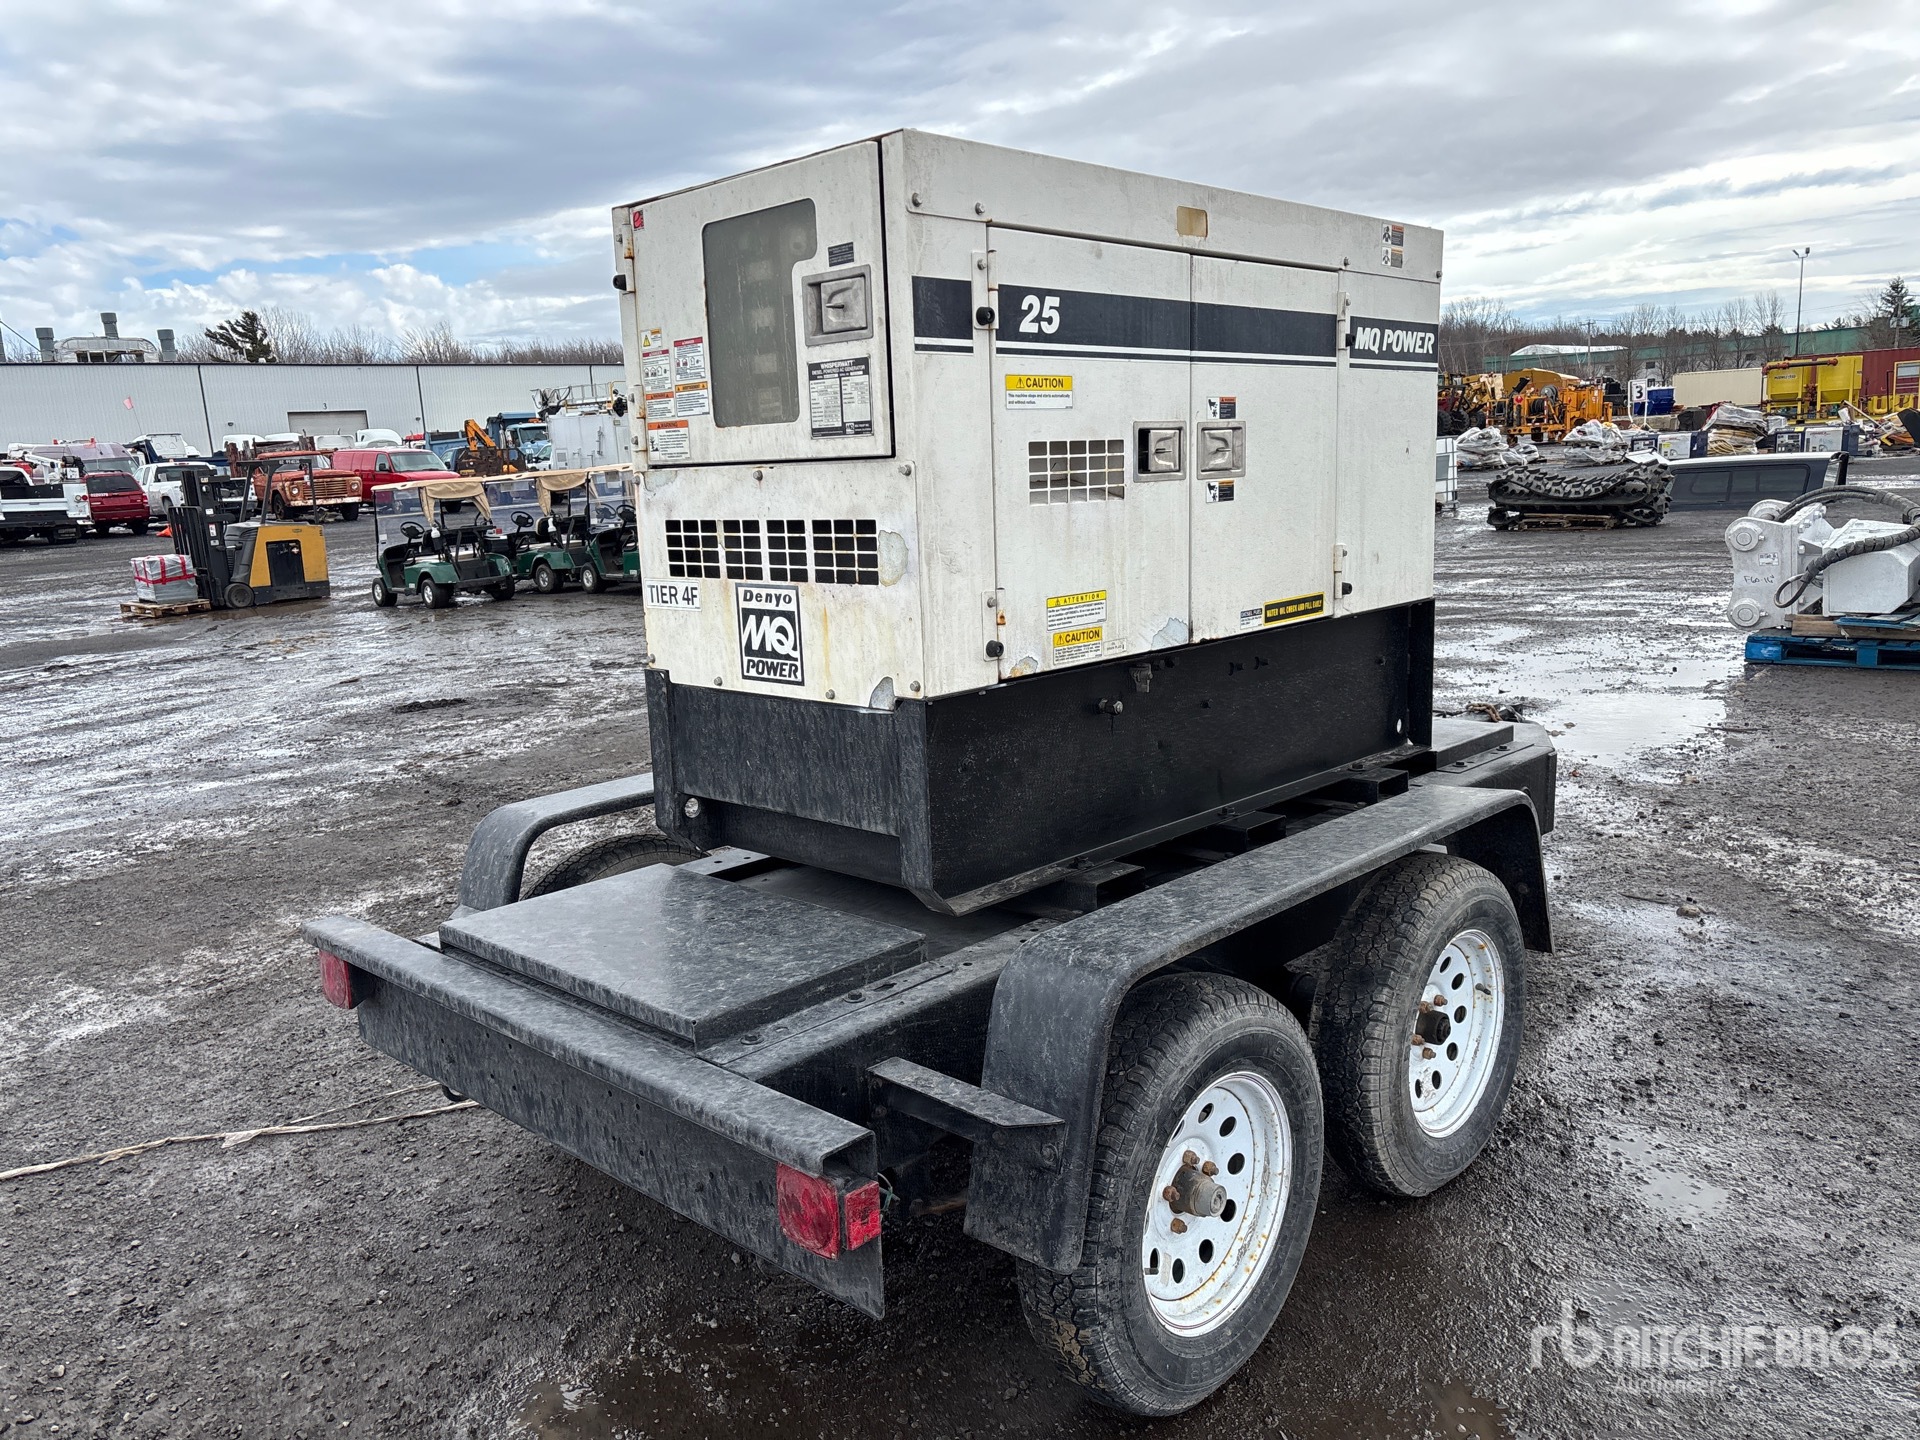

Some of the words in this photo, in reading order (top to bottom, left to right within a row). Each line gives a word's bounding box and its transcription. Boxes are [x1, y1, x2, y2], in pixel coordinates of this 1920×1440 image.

[1020, 294, 1060, 334] 25
[1354, 327, 1381, 354] MQ
[1382, 329, 1435, 354] POWER
[1025, 377, 1064, 388] CAUTION
[1635, 385, 1644, 399] 3
[647, 584, 679, 605] TIER
[682, 586, 698, 606] 4F
[743, 589, 792, 607] Denyo
[1063, 593, 1100, 604] ATTENTION
[1286, 604, 1298, 614] CHECK
[743, 614, 799, 658] MQ
[1065, 629, 1100, 643] CAUTION
[746, 658, 799, 680] POWER
